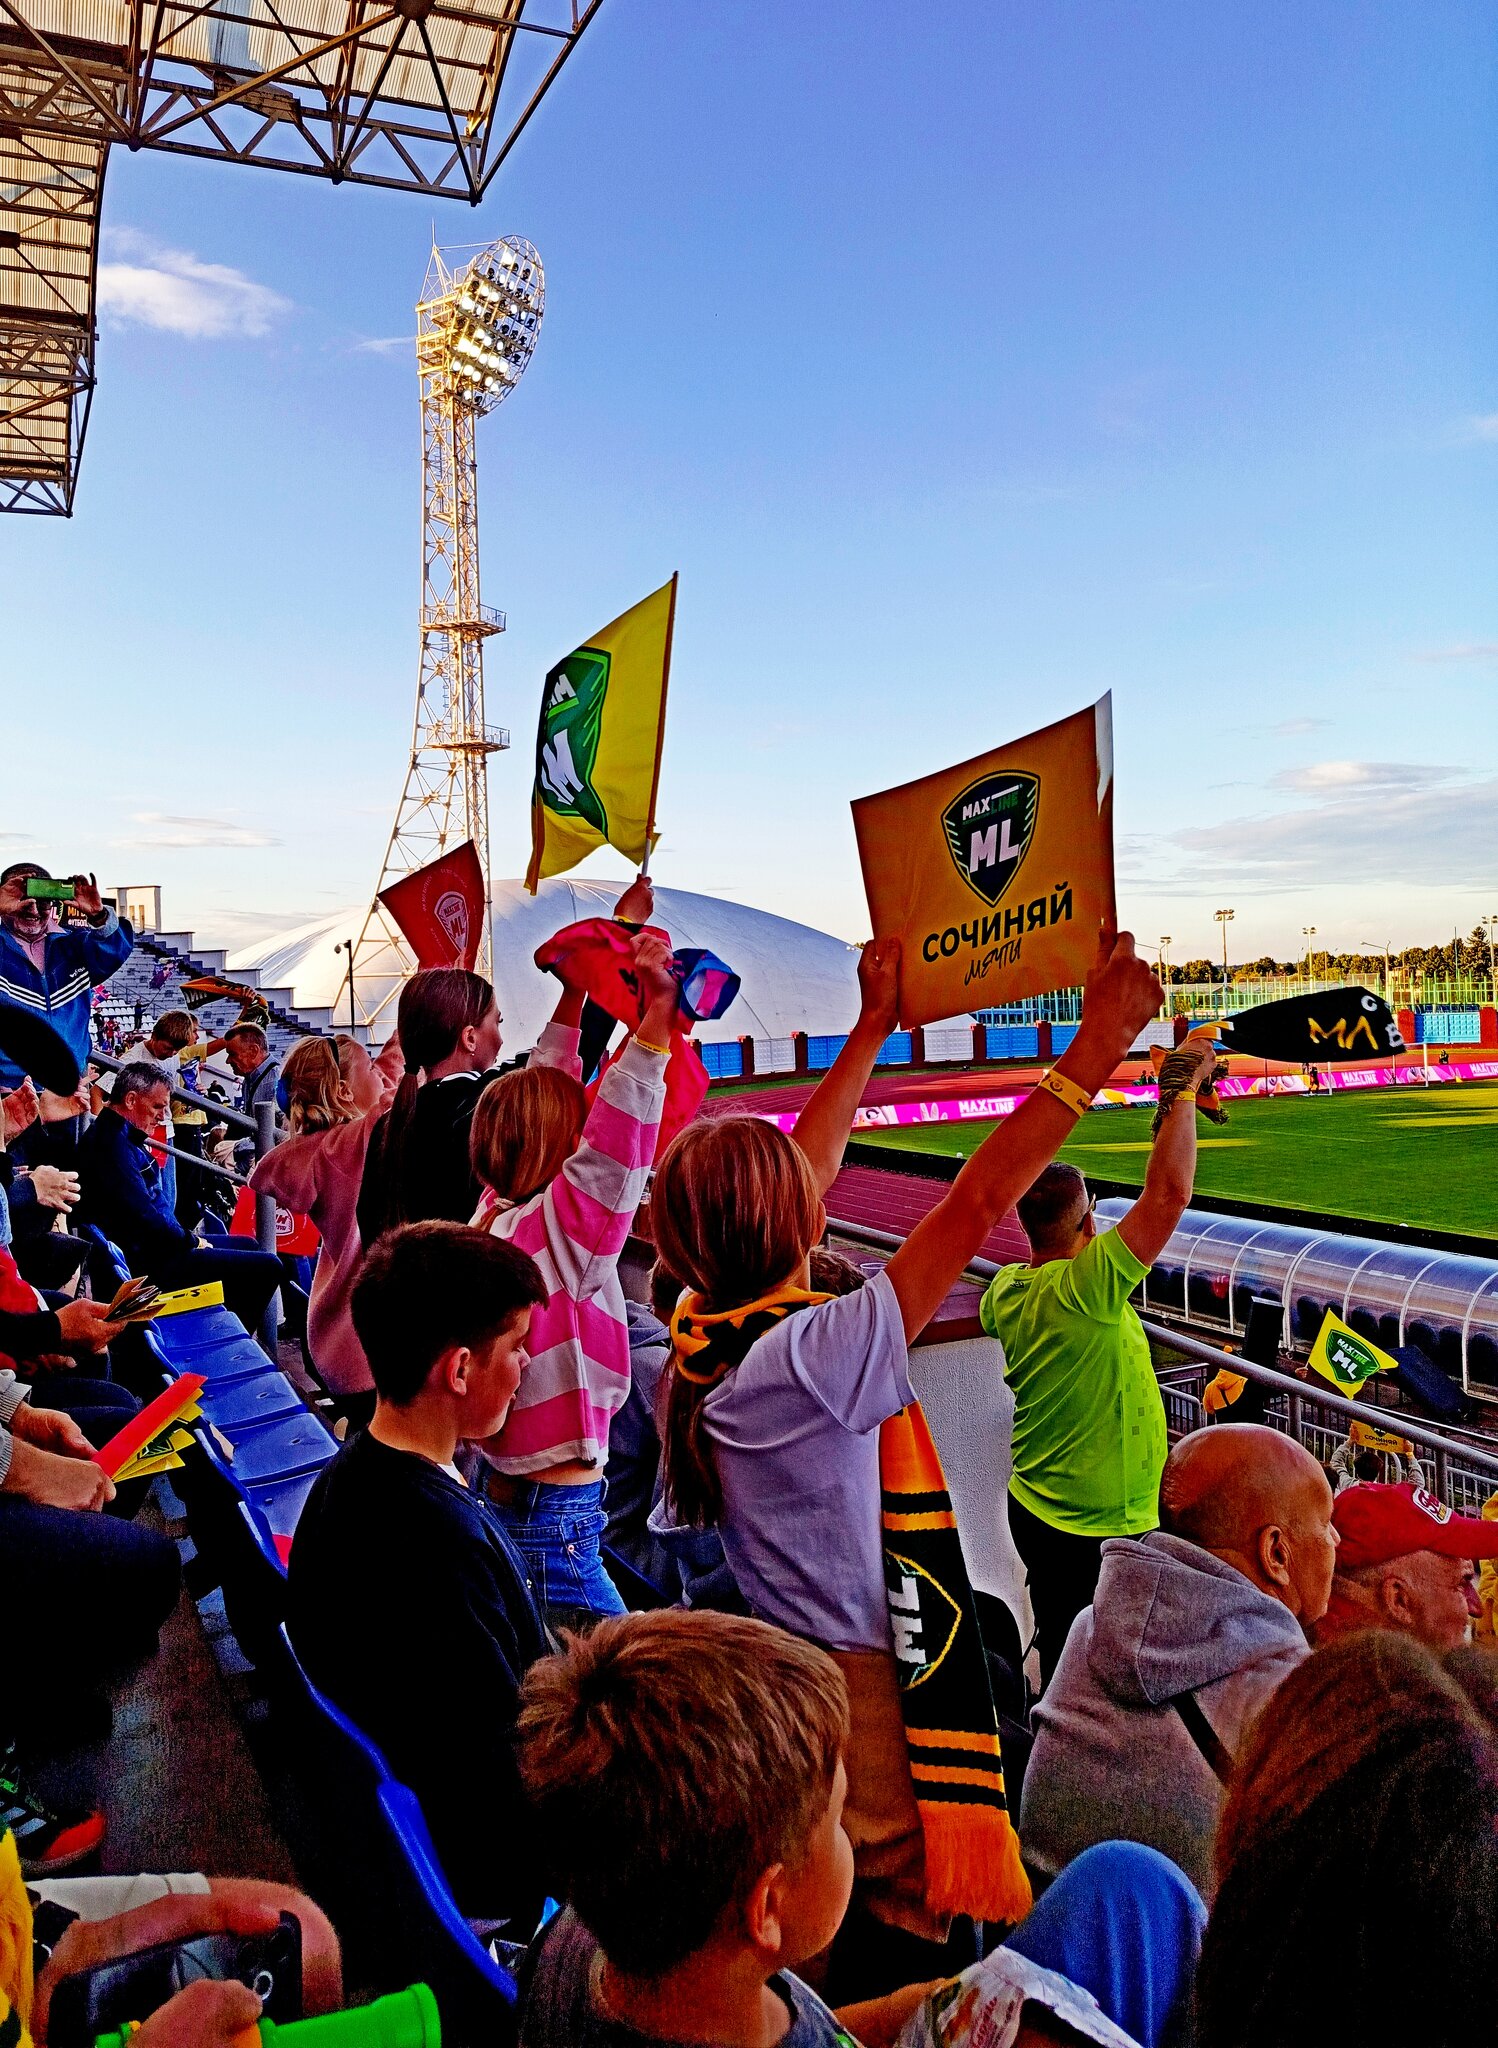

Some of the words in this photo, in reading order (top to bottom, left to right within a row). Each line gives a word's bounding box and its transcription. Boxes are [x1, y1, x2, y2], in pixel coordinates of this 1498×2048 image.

[970, 818, 1019, 873] ML
[922, 881, 1073, 963] СОЧИНЯЙ
[1469, 1063, 1498, 1077] MAXLIN
[1331, 1349, 1358, 1379] ML
